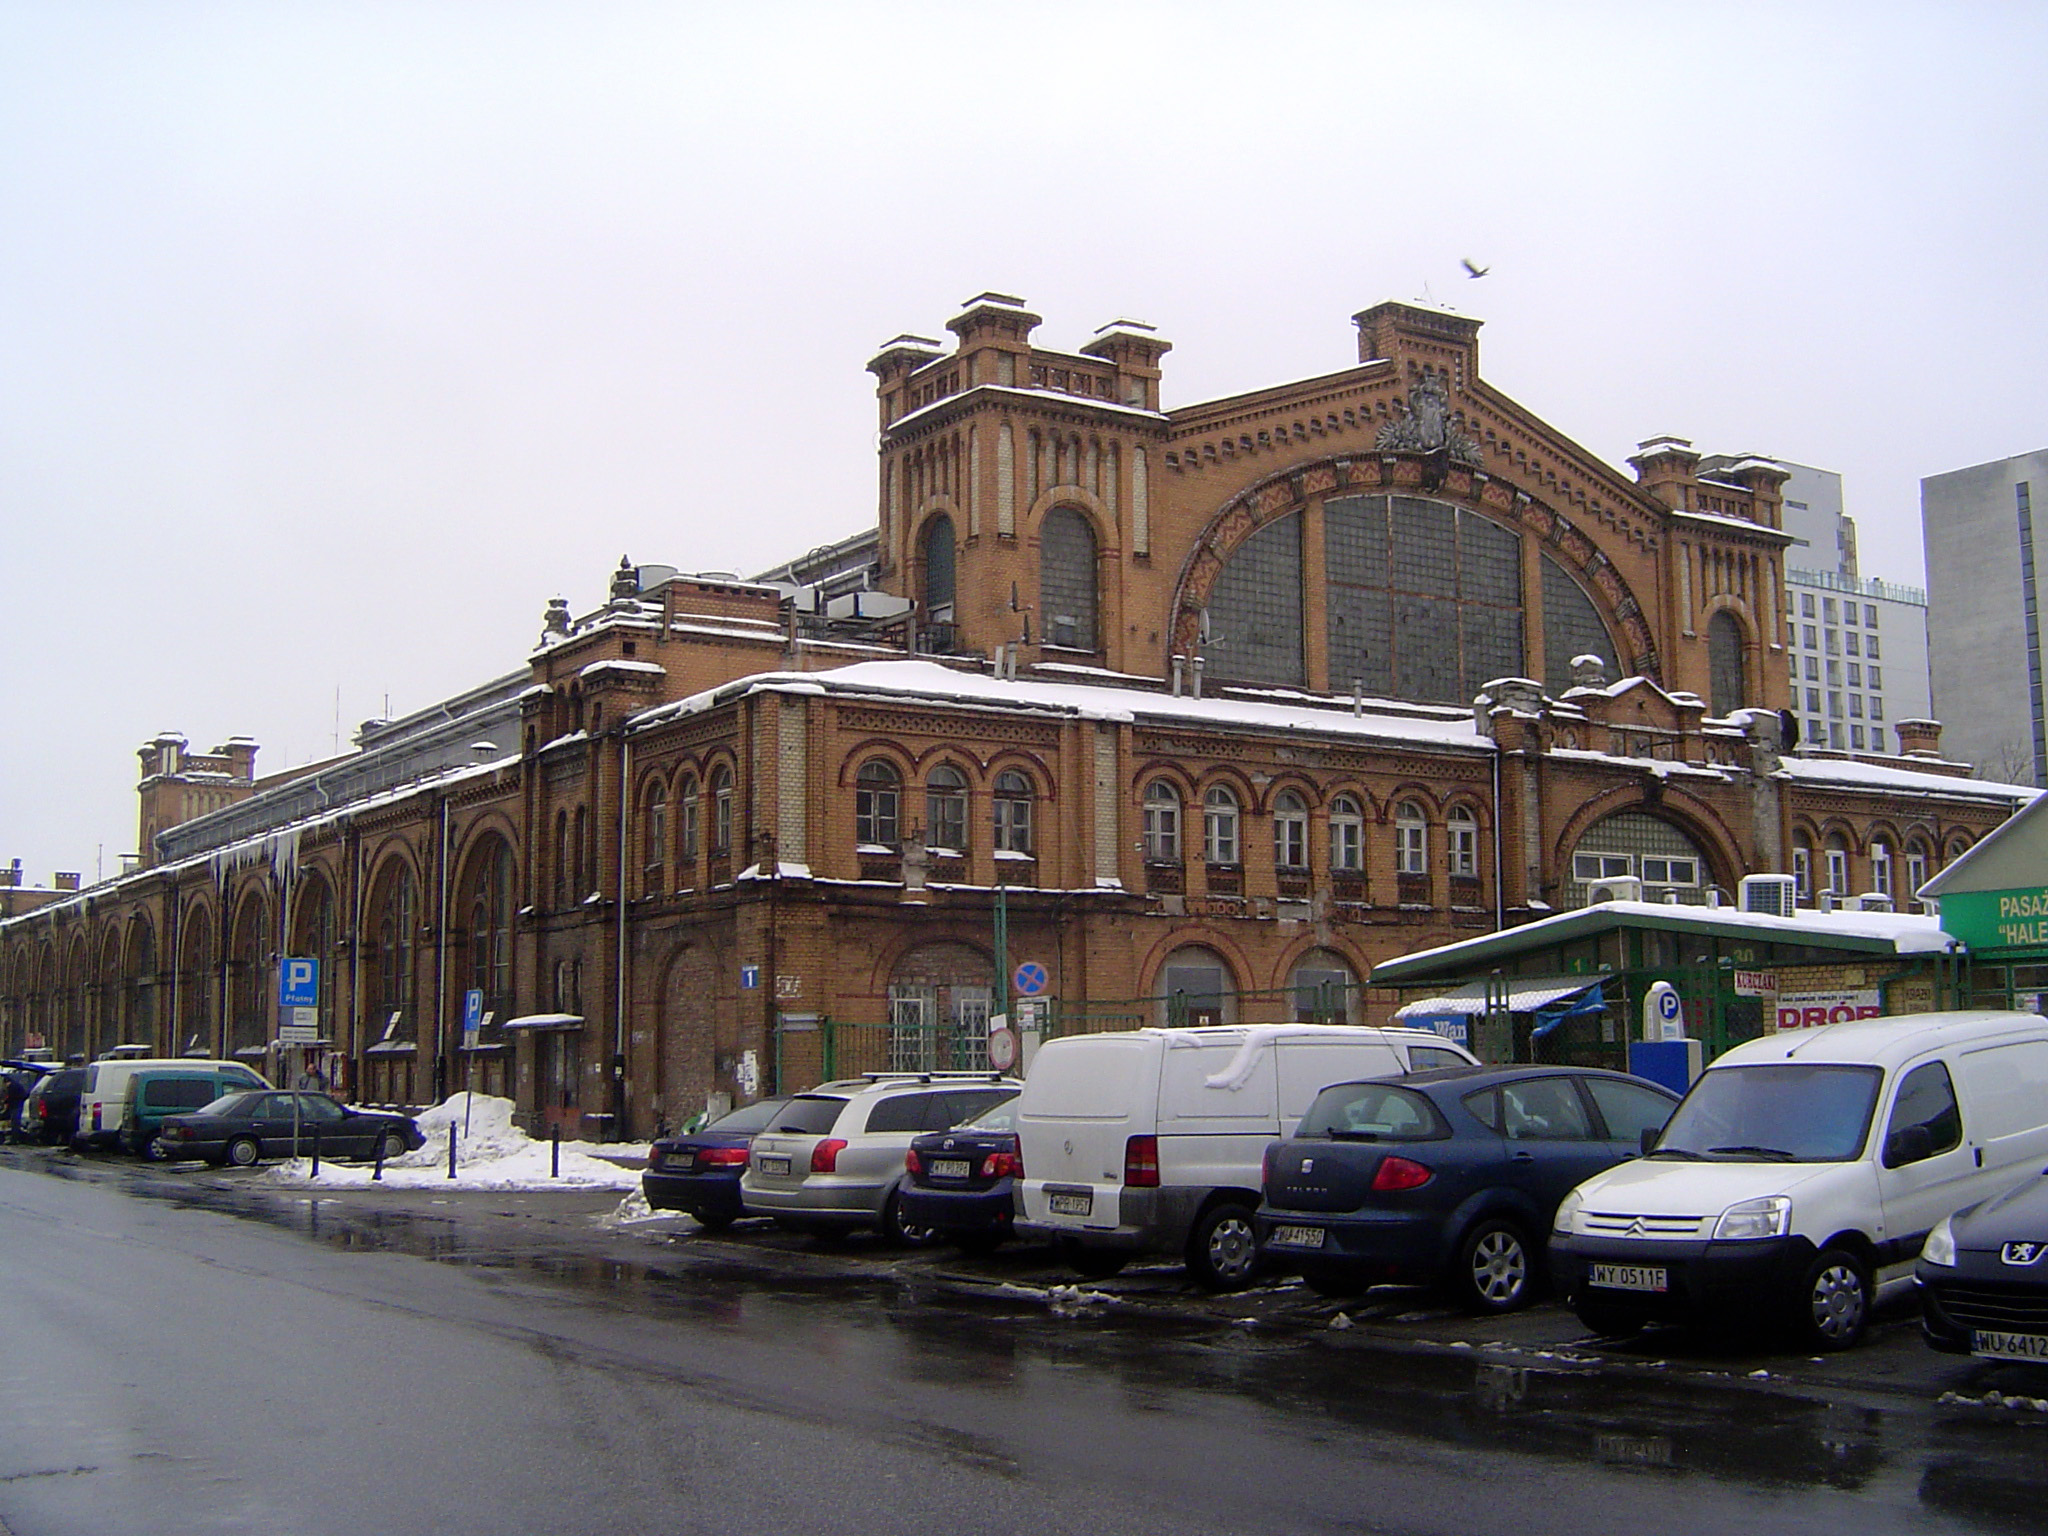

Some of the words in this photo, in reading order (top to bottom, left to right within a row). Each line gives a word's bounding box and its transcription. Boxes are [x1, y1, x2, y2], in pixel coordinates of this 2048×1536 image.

[289, 962, 312, 991] P
[747, 970, 753, 987] 1
[469, 993, 479, 1018] P
[1663, 996, 1676, 1015] P
[1596, 1265, 1615, 1283] WY
[1621, 1268, 1665, 1286] 0511F
[1978, 1332, 2001, 1352] WU
